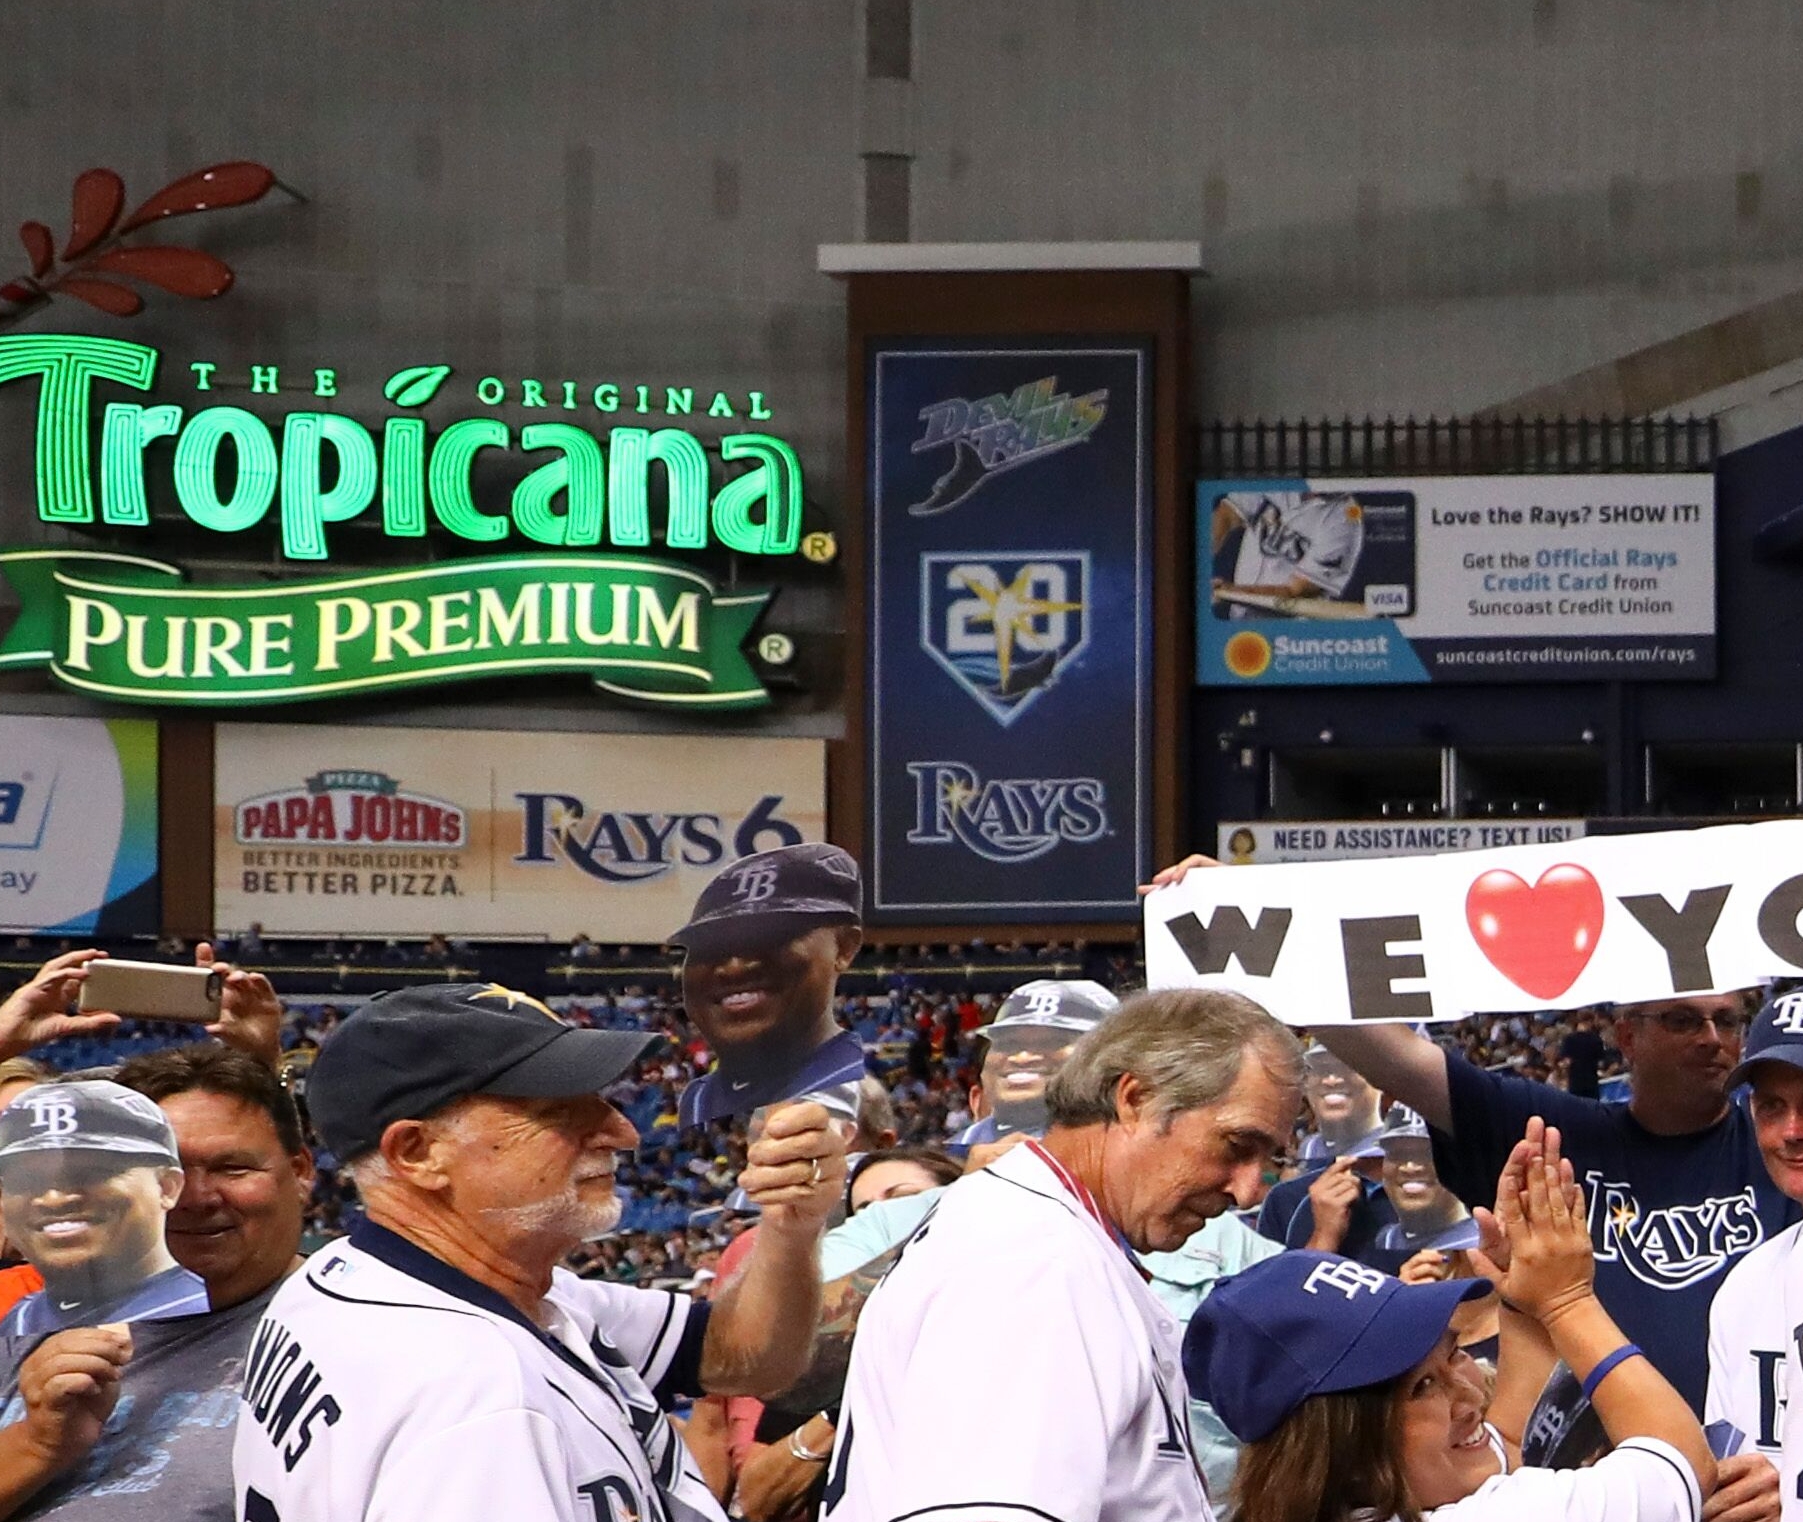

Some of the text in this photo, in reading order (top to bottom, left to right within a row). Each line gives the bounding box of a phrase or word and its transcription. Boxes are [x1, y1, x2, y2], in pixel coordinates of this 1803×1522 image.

[191, 362, 773, 421] THE ORIGINAL
[0, 333, 803, 560] Tropicana
[1430, 504, 1701, 528] Love the Rays? SHOW IT!
[1463, 548, 1678, 571] Get the Official Rays
[1483, 573, 1658, 592] Credit Card from
[1371, 594, 1404, 606] VISA
[1467, 597, 1673, 617] Suncoast Credit Union
[64, 581, 702, 679] PURE PREMIUM
[1273, 634, 1389, 655] Suncoast
[1435, 647, 1697, 665] suncoastcreditunion.com/rays
[1274, 655, 1389, 672] Credit Union
[242, 794, 337, 840] PAPA
[906, 760, 1109, 864] RAYS
[513, 792, 726, 884] RAYS
[1273, 826, 1572, 850] NEED ASSISTANCE? TEXT US!
[242, 851, 322, 868] BETTER
[242, 872, 465, 896] BETTER PIZZA.
[1166, 905, 1433, 1020] WE
[1583, 1169, 1764, 1290] RAYS
[1303, 1259, 1390, 1300] TB
[242, 1318, 342, 1473] MMONS
